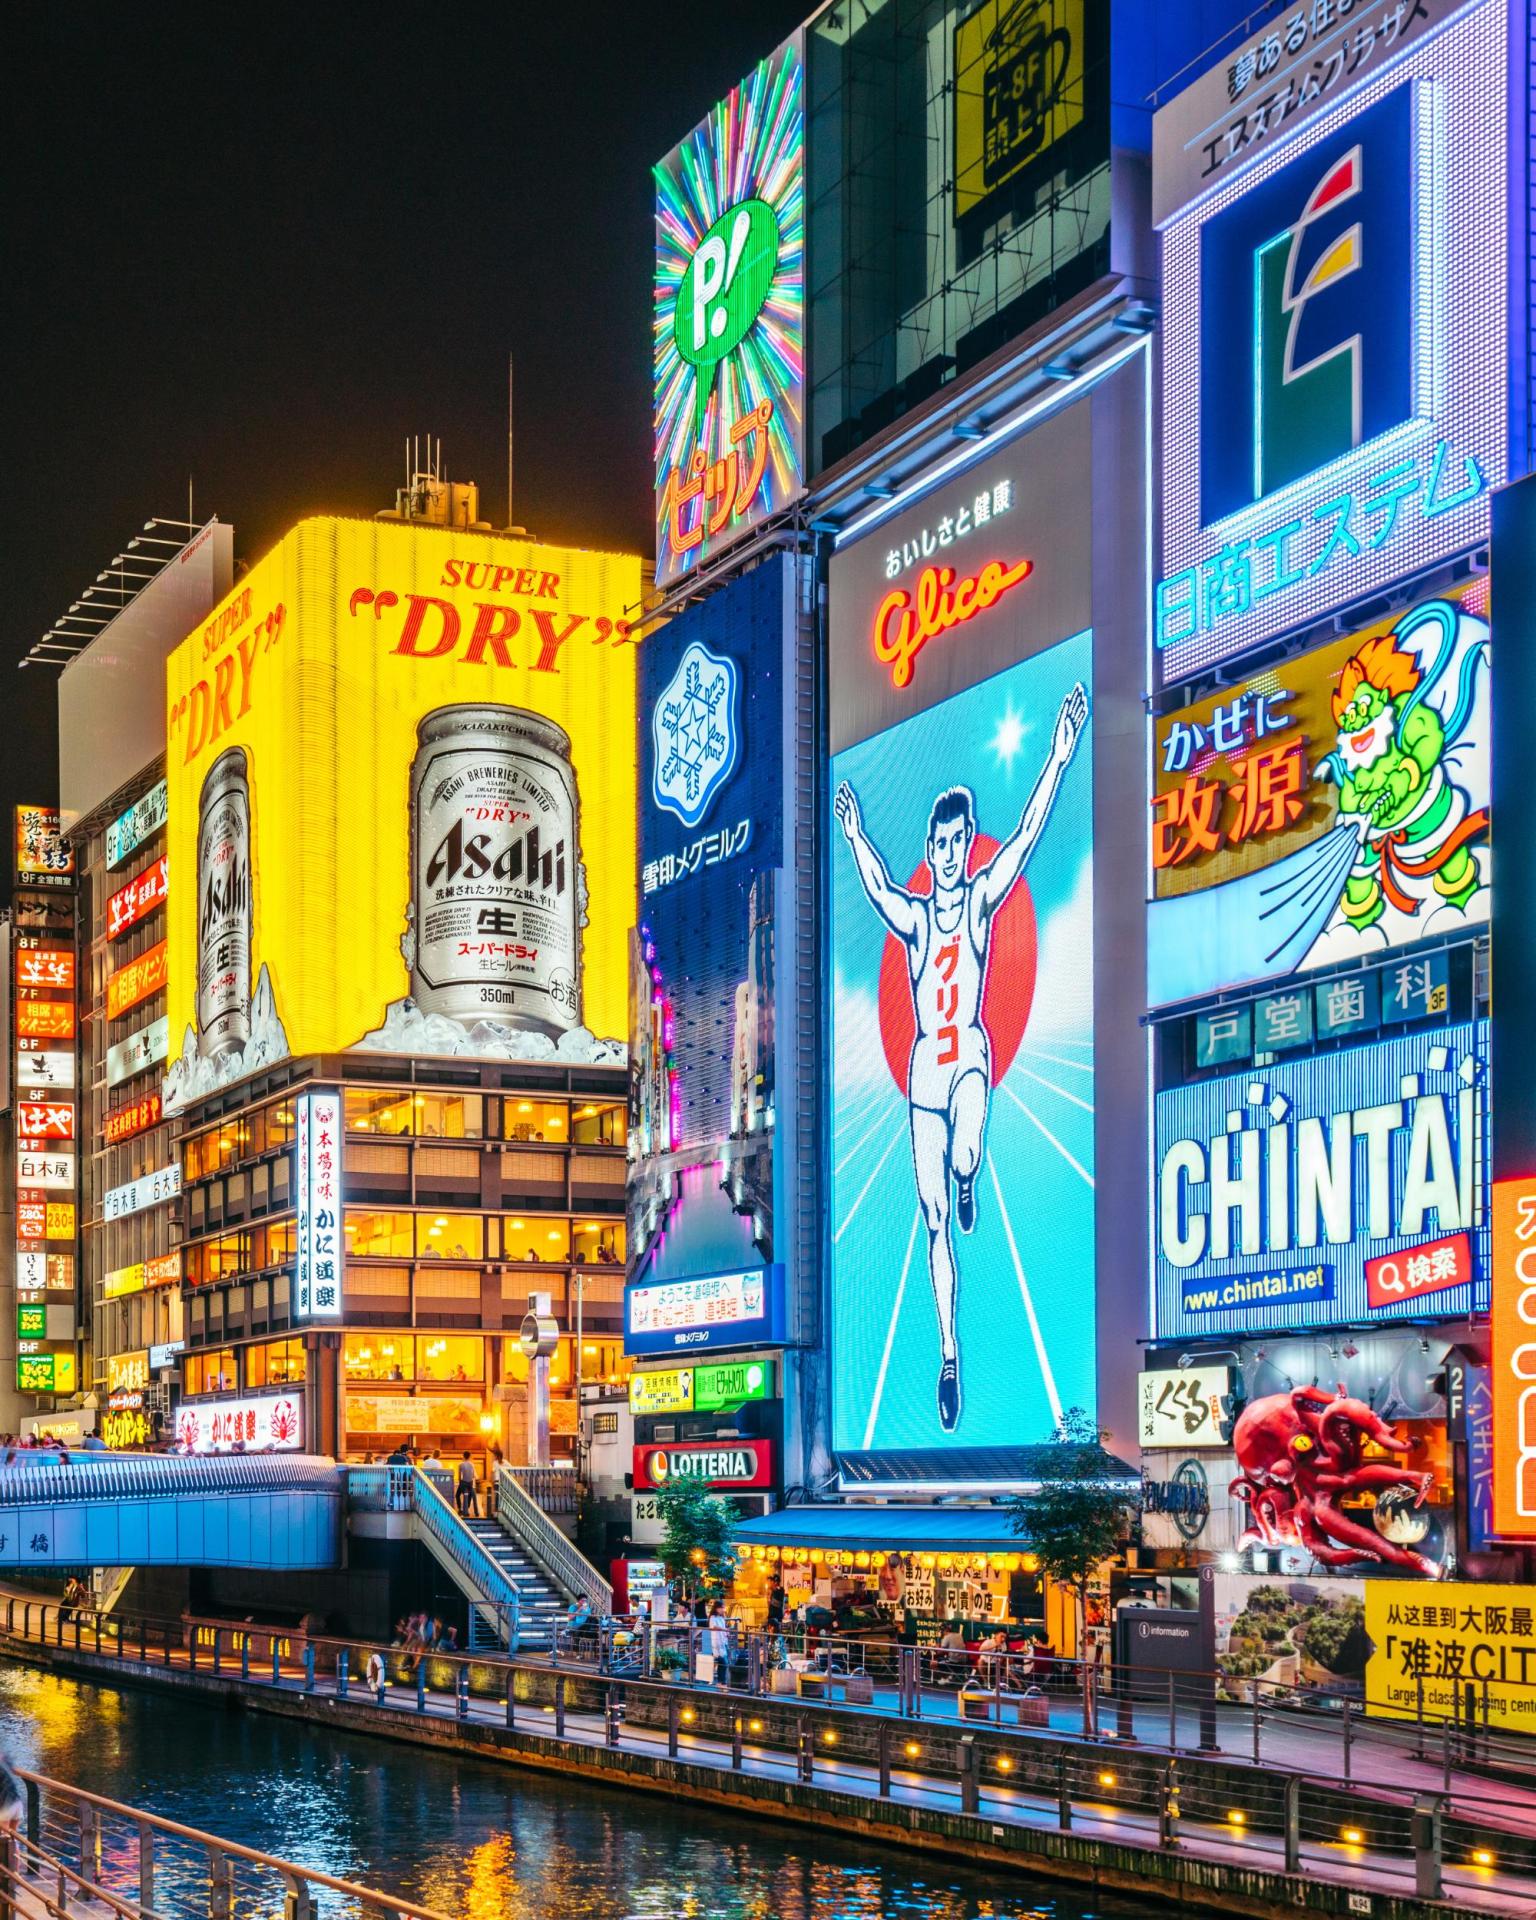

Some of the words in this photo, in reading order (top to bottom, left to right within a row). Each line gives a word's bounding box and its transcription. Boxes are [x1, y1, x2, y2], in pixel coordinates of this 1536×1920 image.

[668, 398, 772, 555] ピップ
[886, 479, 1011, 579] おいしさと健康
[1156, 441, 1483, 651] 日商エステム
[439, 558, 561, 600] SUPER
[202, 587, 252, 662] SUPER
[873, 559, 1032, 688] Glico
[1161, 689, 1290, 773] かぜに
[441, 777, 465, 803] ASAHI
[467, 766, 519, 784] BREWERIES
[521, 778, 551, 813] LIMITED
[483, 800, 510, 808] SUPER
[1151, 736, 1306, 869] 改源
[426, 818, 566, 896] Asahi
[642, 818, 750, 893] 雪印メグミルク
[202, 853, 247, 942] Asahi
[477, 907, 518, 938] 生
[19, 937, 39, 949] 8F
[457, 942, 538, 961] スーパードライ
[20, 988, 39, 999] 7F
[480, 988, 515, 1004] 350ml
[934, 934, 961, 1066] グリコ
[1430, 991, 1445, 1011] 3F
[19, 1039, 39, 1050] 6F
[29, 1090, 45, 1100] 5F
[20, 1107, 72, 1135] はや
[19, 1139, 39, 1150] 4F
[21, 1158, 70, 1178] 白木屋
[316, 1130, 333, 1200] 本場の味
[1160, 1080, 1475, 1269] CHINTAI
[20, 1190, 38, 1201] 3F
[1406, 1246, 1458, 1289] 検索
[20, 1291, 39, 1302] 1F
[1451, 1366, 1463, 1419] 2F
[670, 1452, 747, 1477] LOTTERIA
[905, 1587, 934, 1608] お好み
[947, 1589, 993, 1612] 兄貴の店
[1150, 1625, 1189, 1638] information
[1386, 1604, 1534, 1637] 从这里到大阪最
